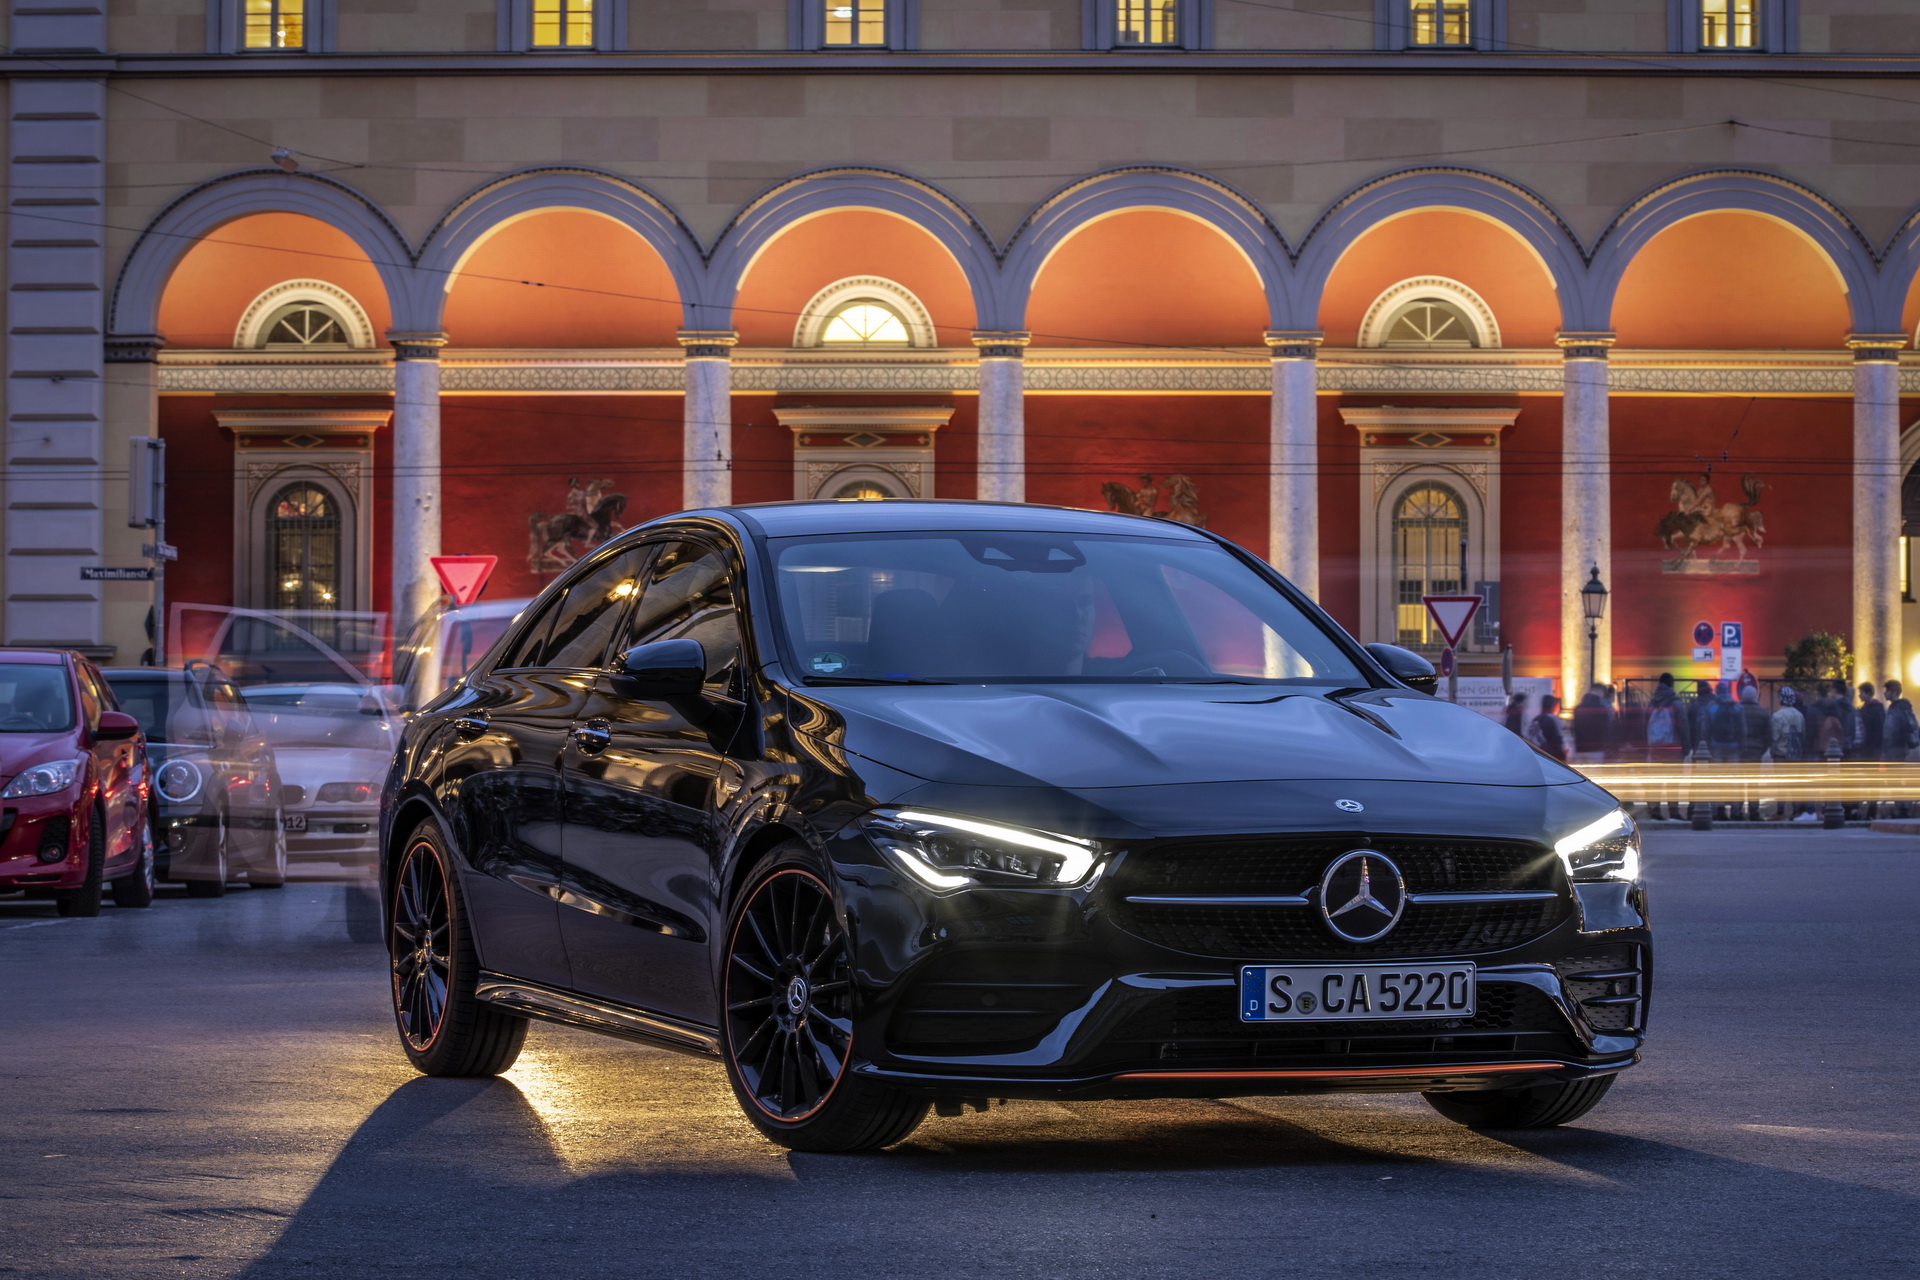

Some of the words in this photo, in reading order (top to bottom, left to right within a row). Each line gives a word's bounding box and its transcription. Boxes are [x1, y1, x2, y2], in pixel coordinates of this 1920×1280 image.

[1724, 626, 1737, 645] P
[287, 816, 303, 829] 12
[1268, 974, 1293, 1014] S
[1322, 973, 1371, 1013] CA
[1379, 971, 1468, 1012] 5220
[1249, 999, 1259, 1011] D
